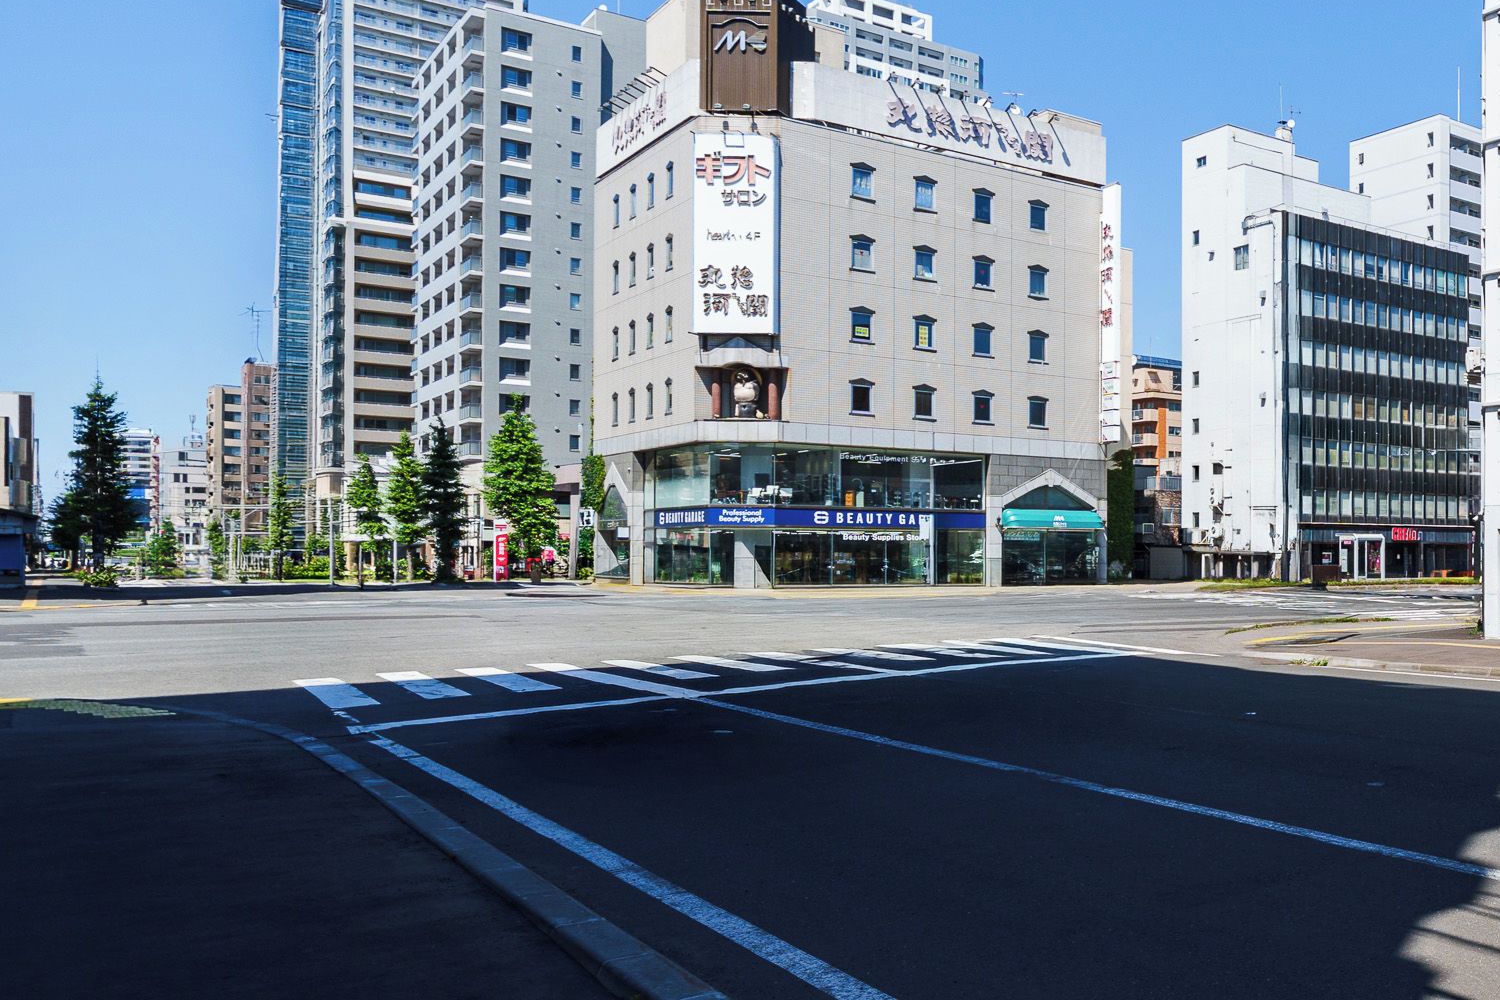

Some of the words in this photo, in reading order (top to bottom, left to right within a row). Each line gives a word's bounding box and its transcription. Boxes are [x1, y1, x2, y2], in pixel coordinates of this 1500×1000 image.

[695, 151, 771, 186] ギフト
[721, 189, 767, 207] サロン
[665, 511, 684, 524] BEAUTY
[685, 511, 705, 523] GARAGE
[722, 509, 762, 517] Professional
[836, 512, 893, 524] BEAUTY
[718, 516, 742, 524] Beauty
[742, 516, 765, 524] Supply
[843, 533, 869, 542] Beauty
[872, 533, 905, 542] Supplies
